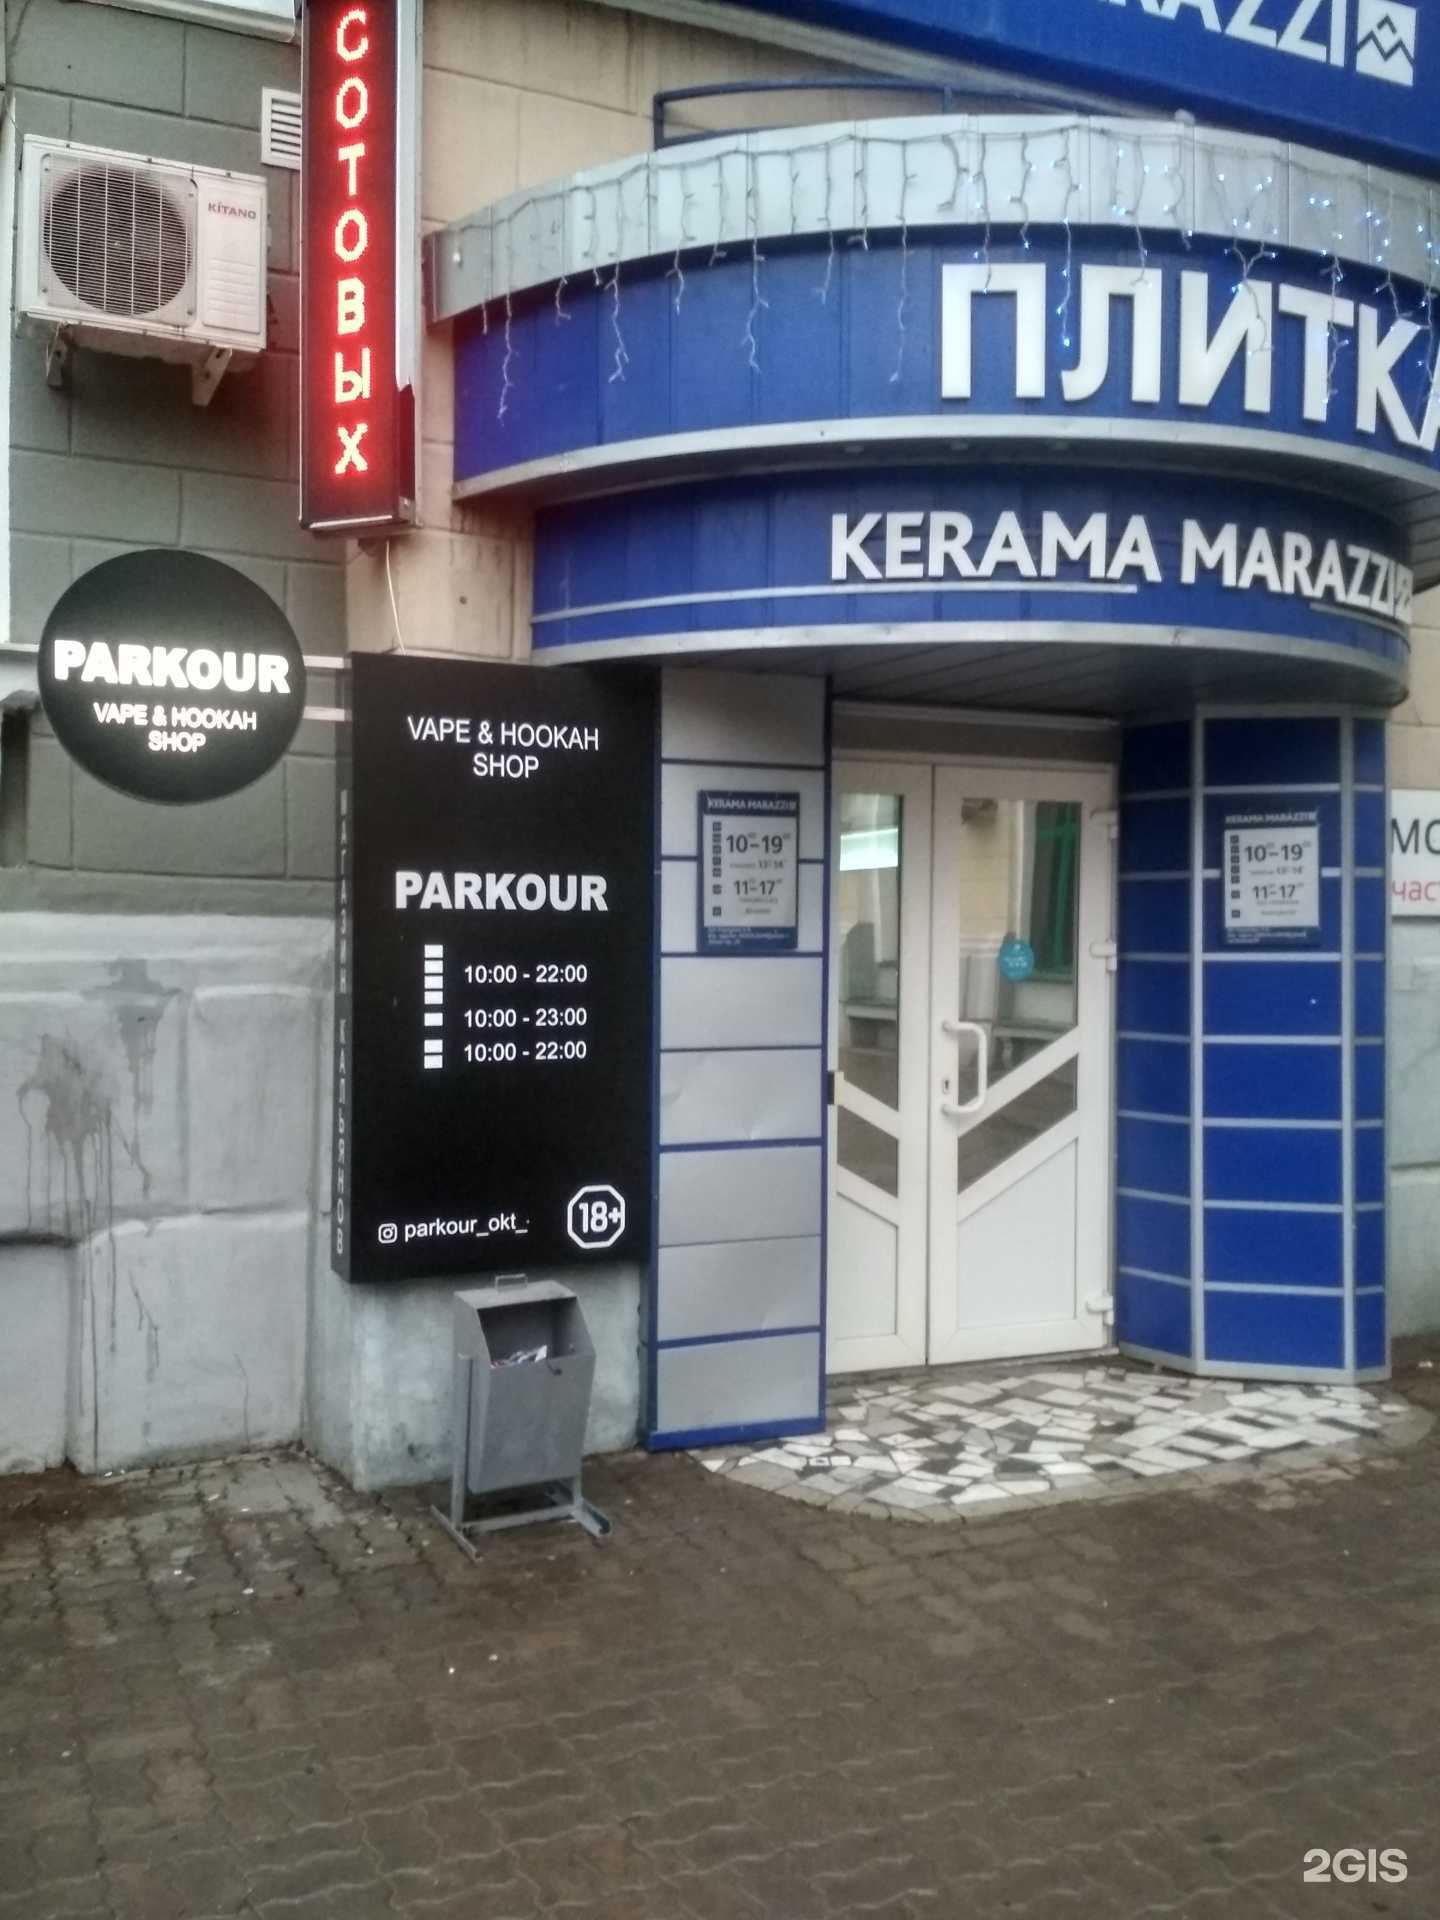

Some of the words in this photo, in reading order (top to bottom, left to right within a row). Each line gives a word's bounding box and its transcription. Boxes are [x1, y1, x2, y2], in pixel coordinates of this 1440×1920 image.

[208, 201, 257, 220] KITANO
[335, 8, 371, 474] СОТОВЫХ
[831, 510, 1162, 583] KERAMA
[1180, 518, 1396, 617] MARAZZI
[53, 639, 291, 693] PARKOUR
[93, 702, 149, 726] VAPE
[152, 705, 168, 727] &
[172, 706, 258, 731] HOOKAH
[148, 730, 207, 753] SHOP
[407, 715, 471, 744] VAPE
[477, 720, 494, 745] &
[500, 722, 599, 751] HOOKAH
[472, 752, 540, 779] SHOP
[395, 870, 609, 912] PARKOUR
[464, 964, 517, 984] 10:00
[535, 964, 587, 983] 22:00
[464, 1008, 517, 1028] 10:00
[535, 1007, 587, 1027] 23:00
[464, 1042, 517, 1062] 10:00
[535, 1041, 587, 1060] 22:00
[335, 1018, 347, 1255] КАЛЬЯНОВ
[578, 1201, 620, 1234] 18+
